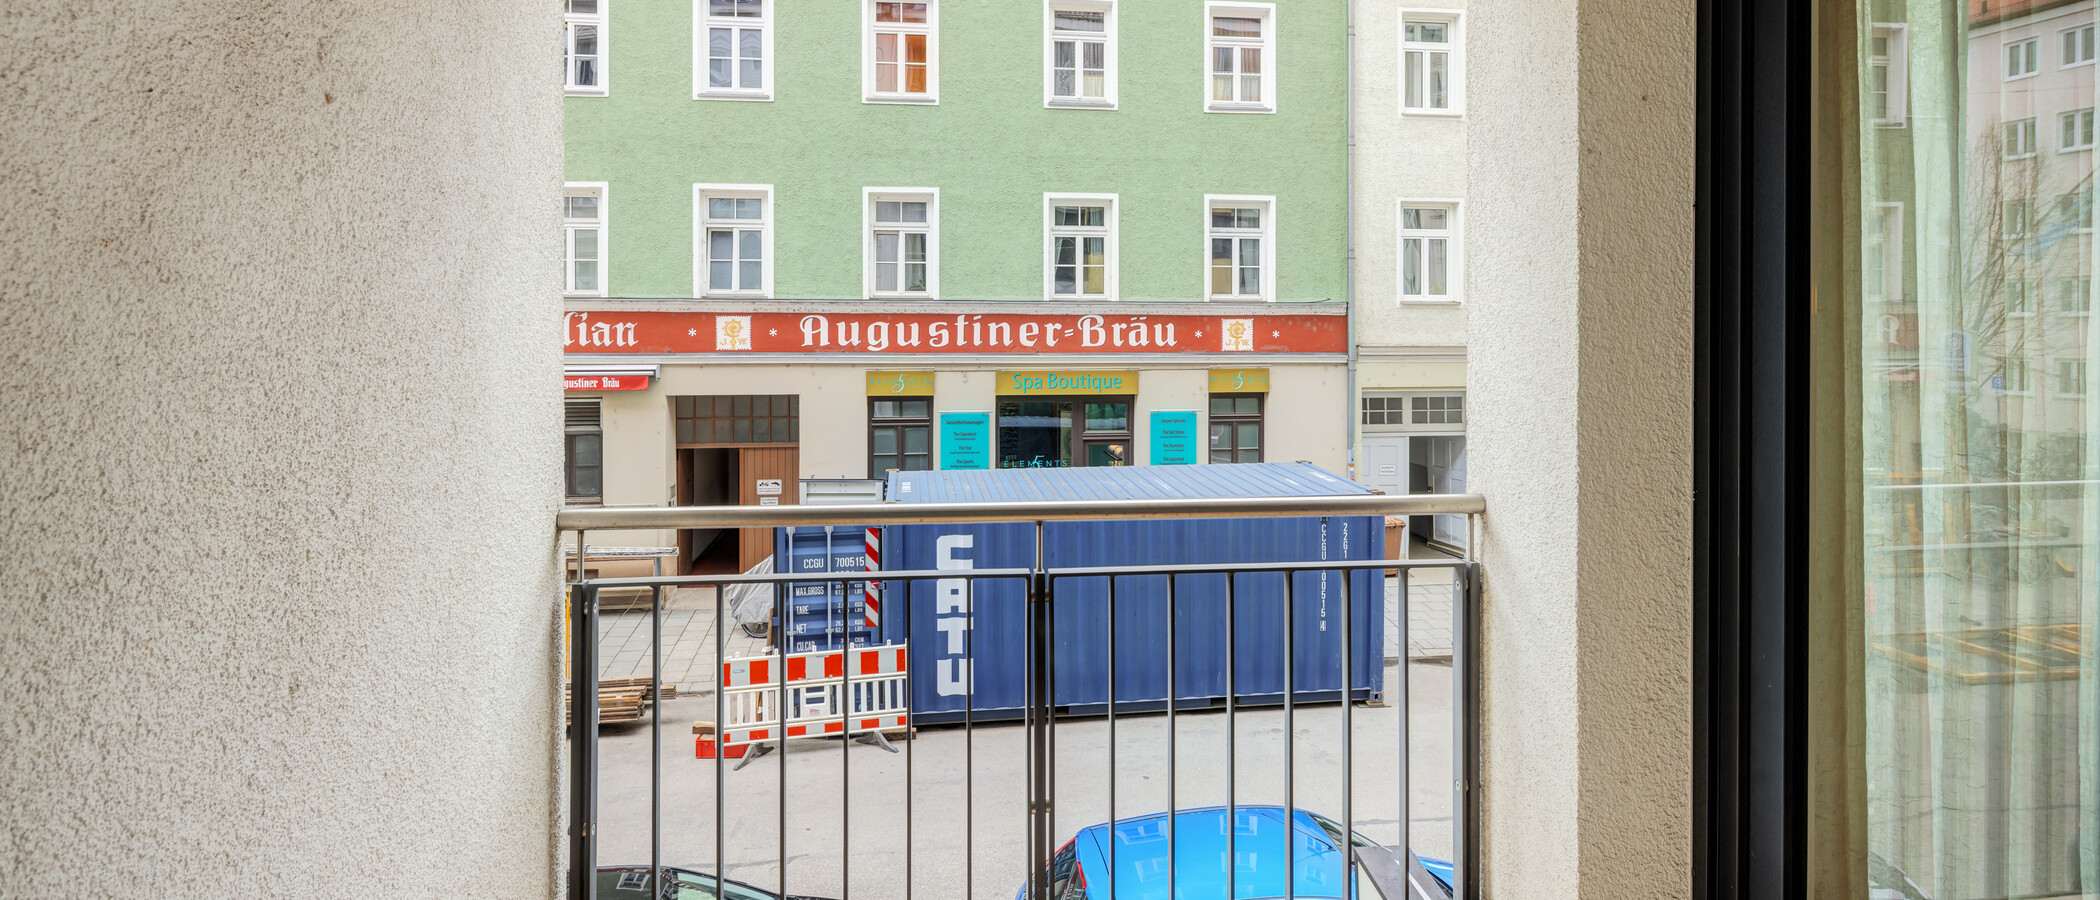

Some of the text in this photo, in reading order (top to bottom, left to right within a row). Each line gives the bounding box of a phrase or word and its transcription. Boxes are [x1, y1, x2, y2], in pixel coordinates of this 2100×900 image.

[563, 312, 639, 347] lian
[602, 376, 620, 389] Bräu
[869, 378, 931, 386] ELEMENTS
[1012, 373, 1122, 393] Spa Boutique
[1003, 460, 1068, 468] ELEMENTS
[803, 556, 865, 569] CCGU 700515
[795, 585, 824, 596] MAX.GROSS
[795, 605, 809, 615] TARE
[796, 623, 807, 634] NET
